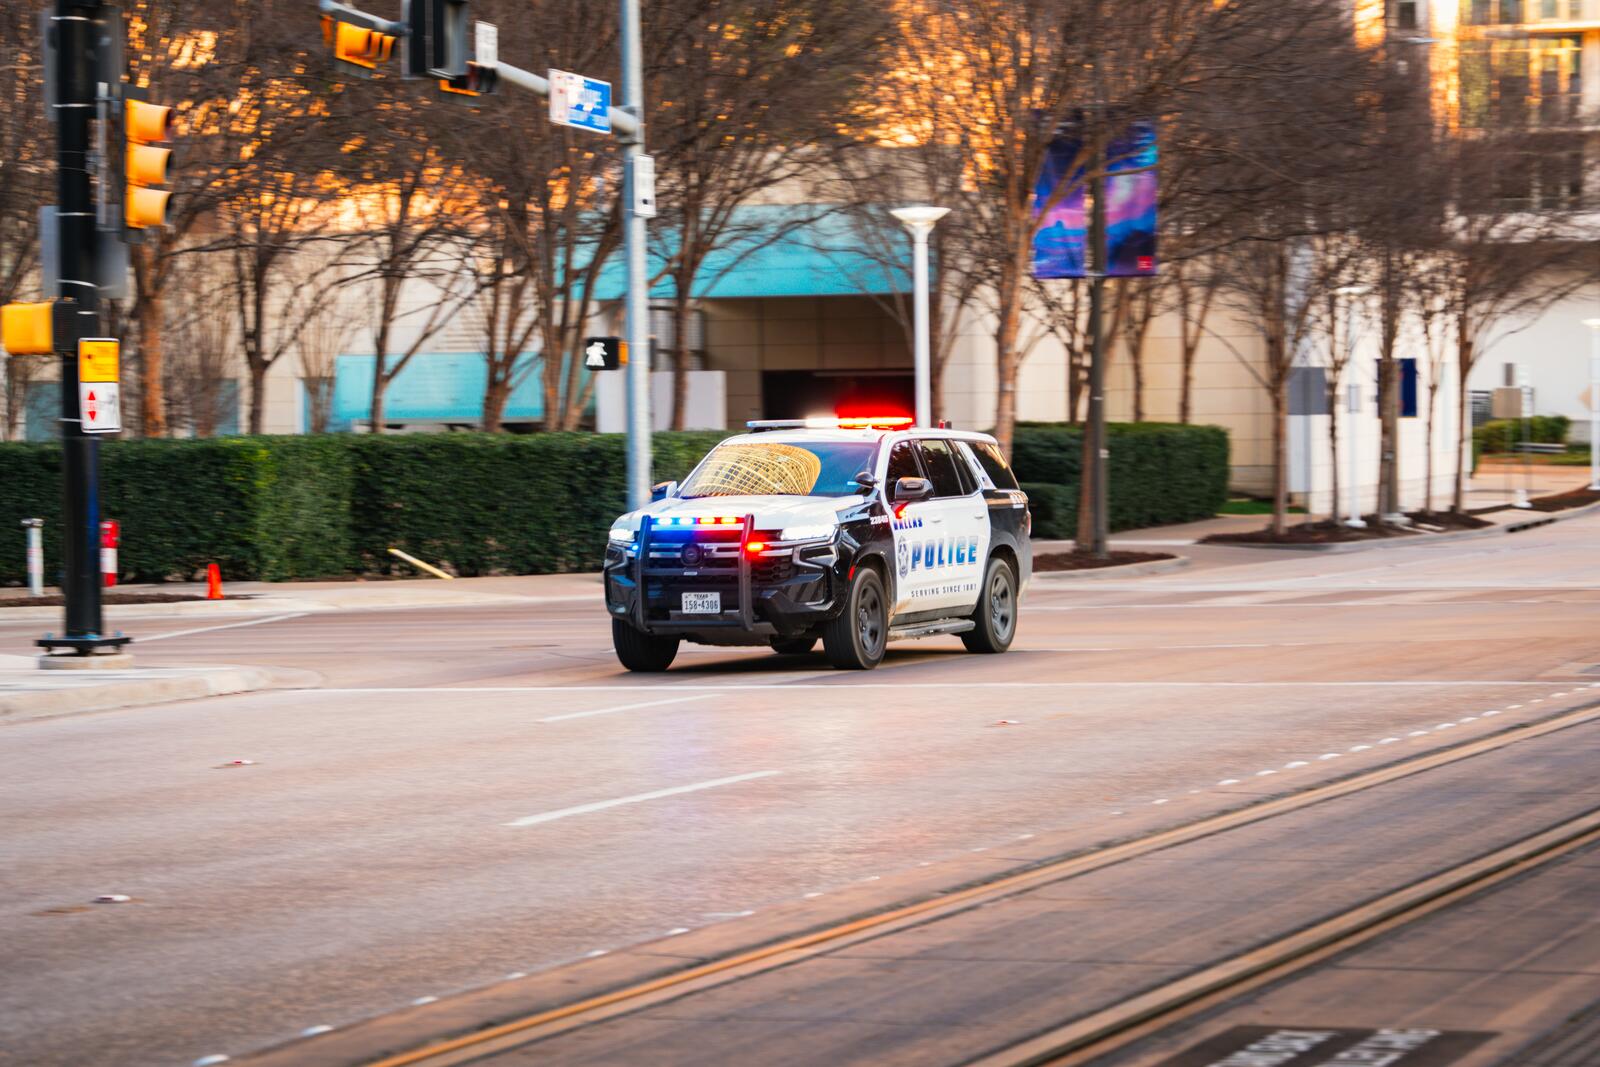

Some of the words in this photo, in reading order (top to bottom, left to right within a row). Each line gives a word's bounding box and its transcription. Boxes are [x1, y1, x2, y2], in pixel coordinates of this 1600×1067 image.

[911, 536, 979, 571] POLICE
[911, 587, 940, 597] SERVING
[943, 584, 961, 594] SINCE
